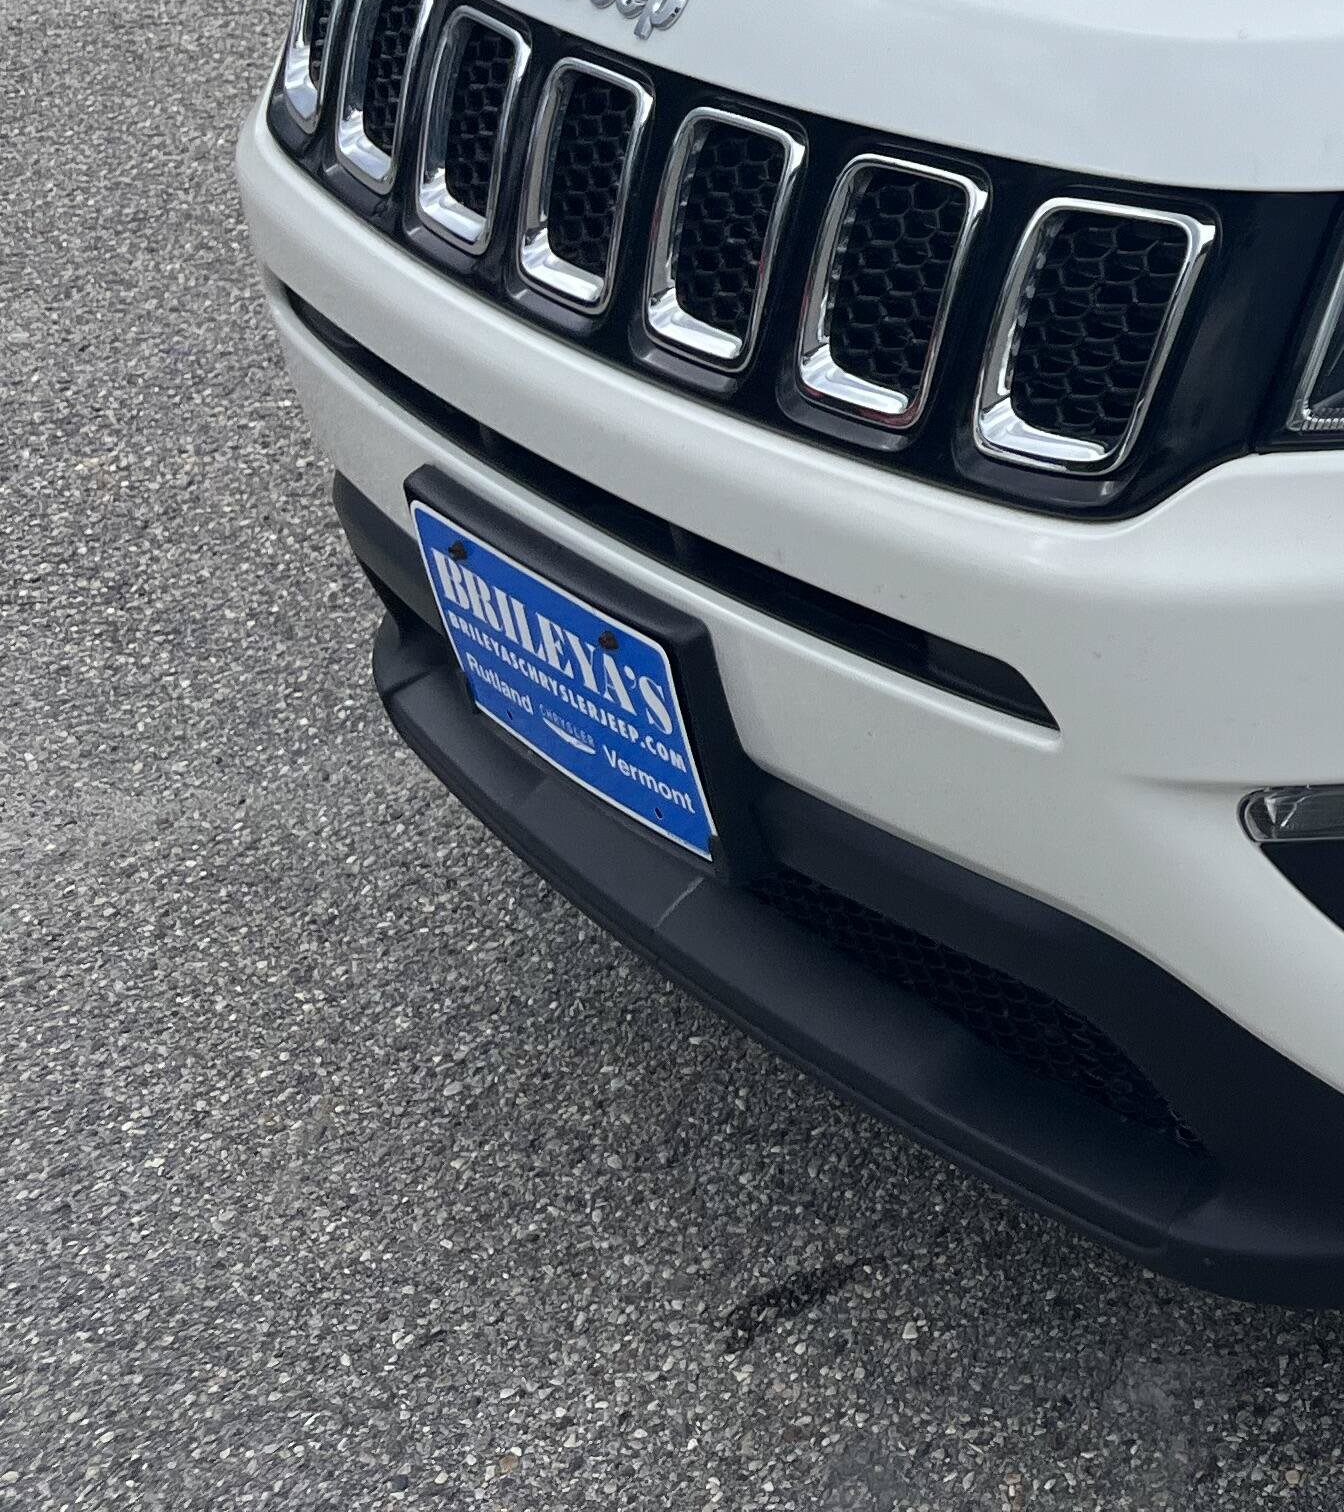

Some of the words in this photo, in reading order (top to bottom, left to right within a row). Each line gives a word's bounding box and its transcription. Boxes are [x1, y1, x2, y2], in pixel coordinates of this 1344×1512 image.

[431, 547, 673, 735] BRILEYA'S
[447, 609, 687, 773] BRILEYASCHRYSLERJEEP.COM
[465, 651, 534, 716] Rutland
[539, 703, 595, 749] CHRYSLER
[602, 744, 696, 814] Vermont
